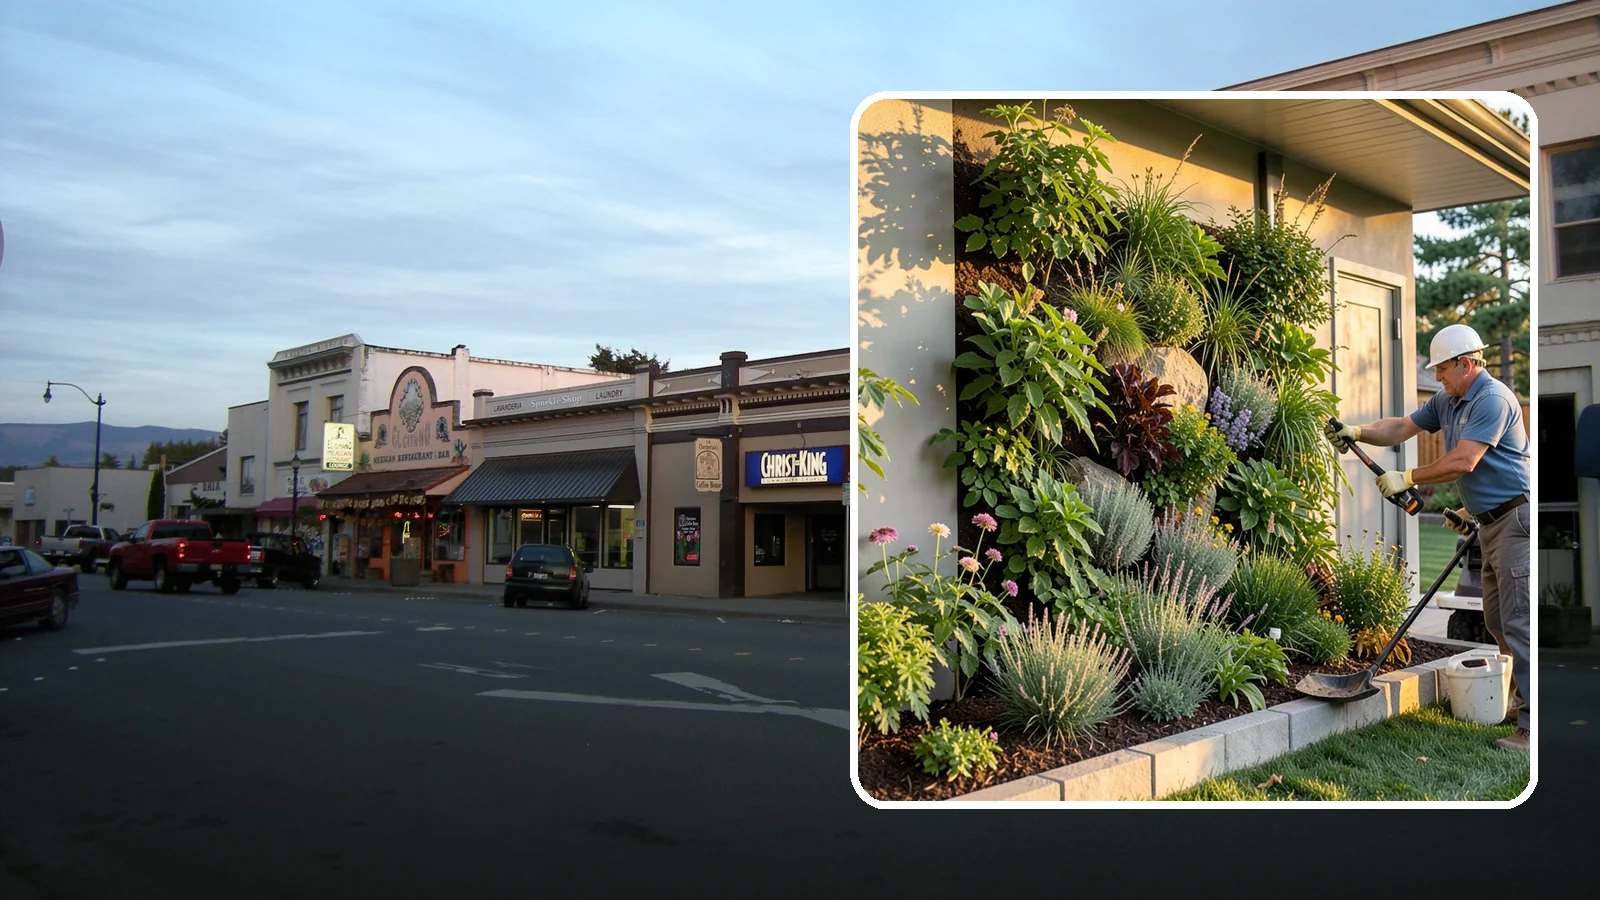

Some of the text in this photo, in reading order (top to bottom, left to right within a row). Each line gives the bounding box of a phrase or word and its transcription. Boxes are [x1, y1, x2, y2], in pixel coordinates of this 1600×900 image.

[493, 402, 523, 413] LAVANDERIA
[562, 394, 583, 404] Shop
[595, 389, 624, 400] LAUNDRY
[373, 455, 396, 464] MEXICAN
[397, 451, 433, 463] RESTAURANT
[437, 450, 450, 459] BAR
[798, 450, 828, 476] KING
[697, 480, 710, 489] Coffee
